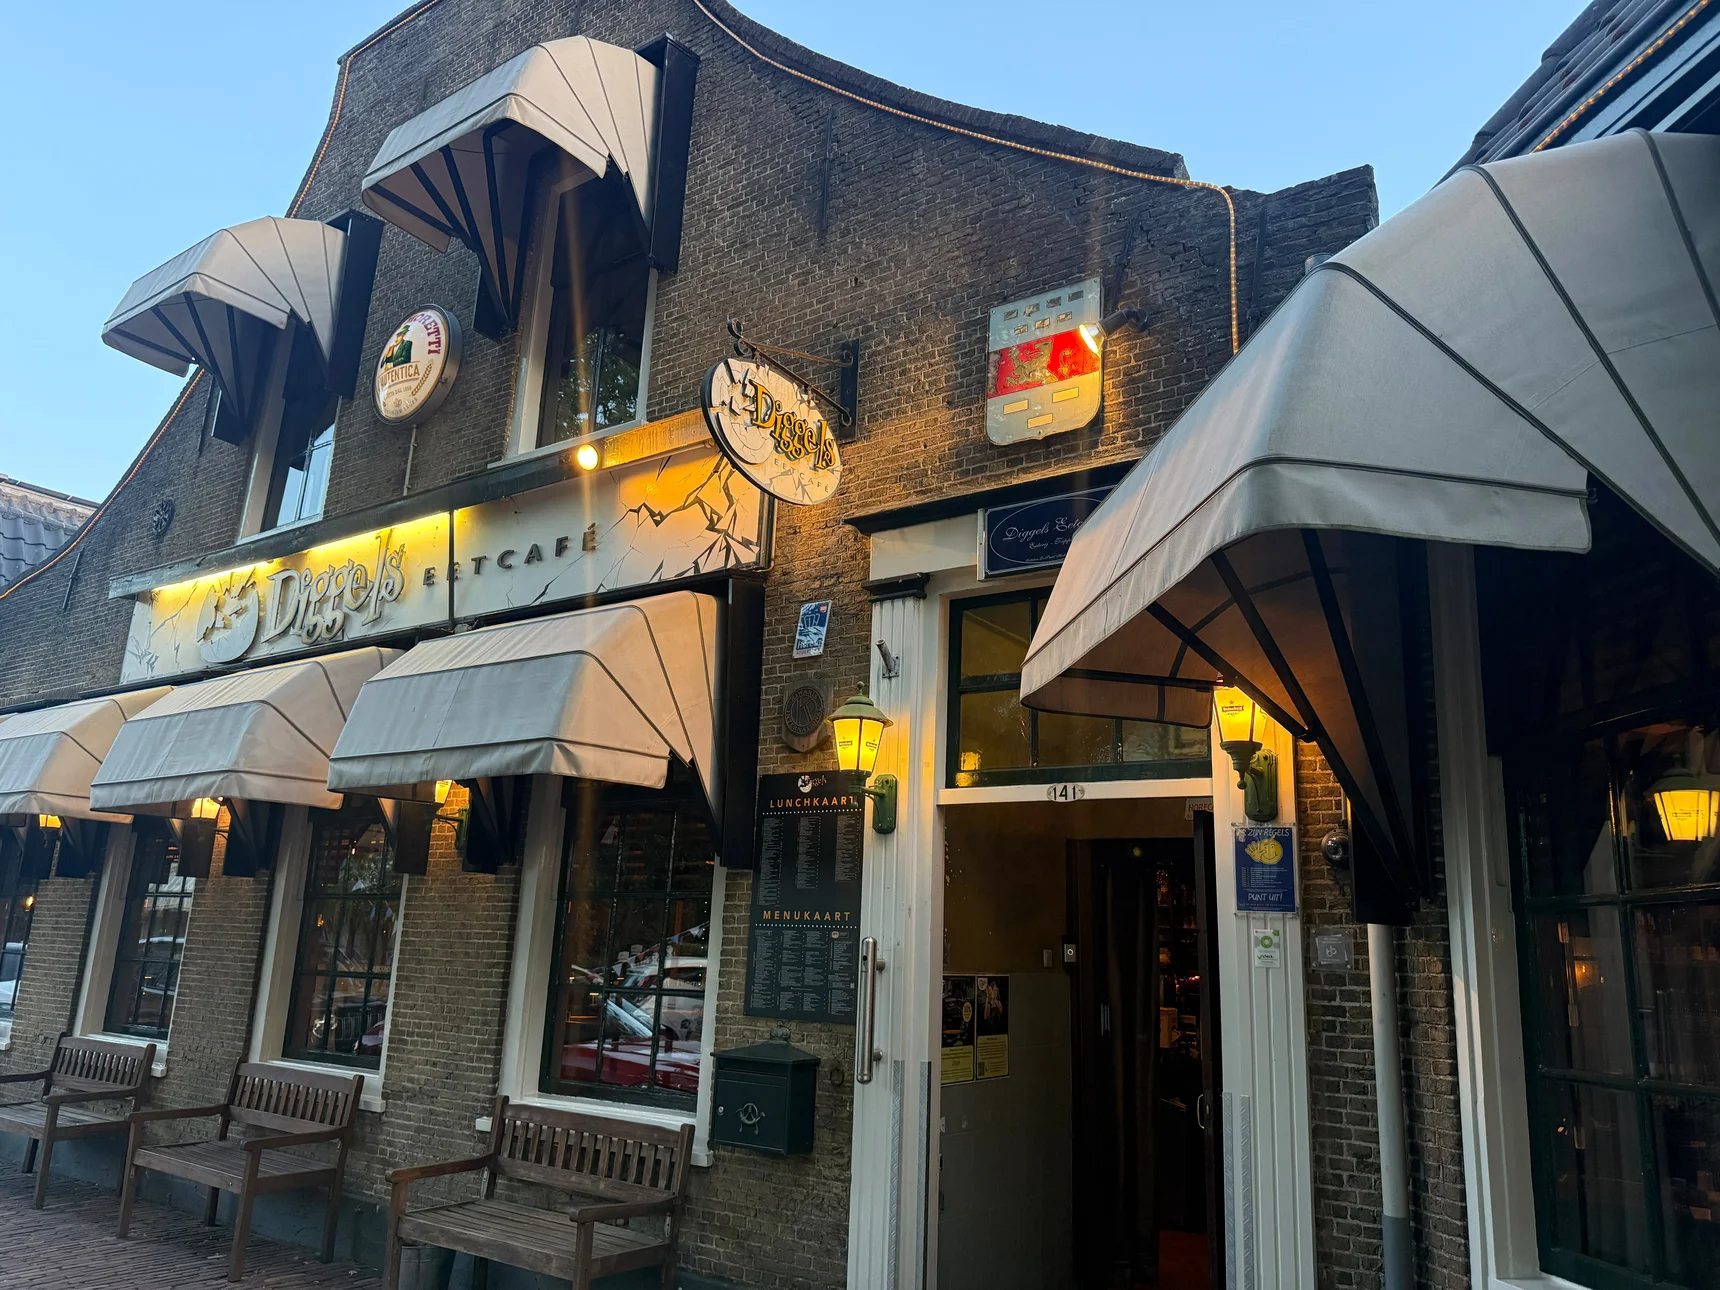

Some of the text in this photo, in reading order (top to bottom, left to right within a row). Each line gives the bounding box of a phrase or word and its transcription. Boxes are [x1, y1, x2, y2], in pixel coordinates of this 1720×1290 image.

[749, 378, 836, 470] Diggels
[1003, 522, 1050, 543] Diggels
[261, 522, 597, 645] Diggels EETCAFÉ
[1053, 784, 1076, 801] 141
[770, 796, 855, 809] LUNCHKAART
[1263, 828, 1290, 838] REGELS
[1247, 892, 1283, 902] PUNT UIT!
[763, 910, 851, 921] MENUKAART
